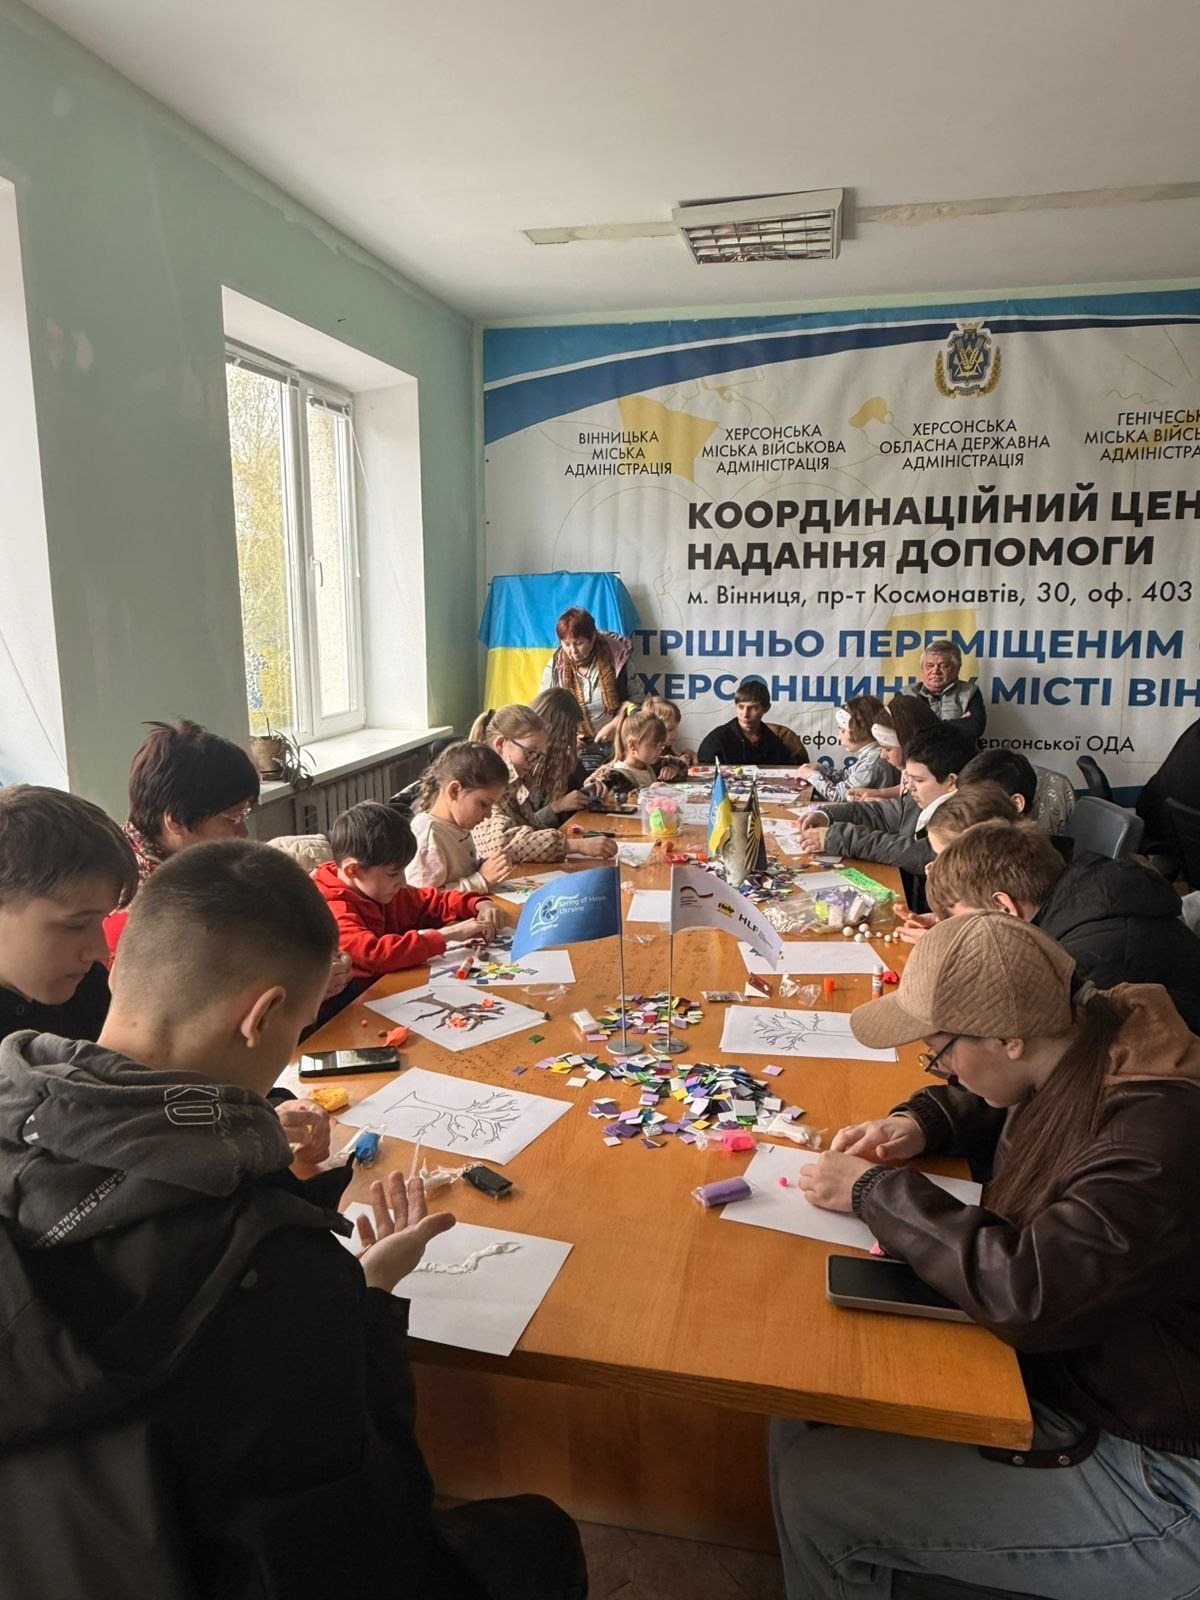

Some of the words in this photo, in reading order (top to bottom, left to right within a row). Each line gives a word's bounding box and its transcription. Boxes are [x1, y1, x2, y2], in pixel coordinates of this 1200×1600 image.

[725, 424, 822, 441] ХЕРСОНСЬКА
[913, 419, 1017, 436] ХЕРСОНСЬКА
[579, 430, 659, 446] ВІННИЦЬКА
[879, 440, 957, 455] ОБЛАСНА
[962, 435, 1051, 452] ДЕРЖАВНА
[1084, 430, 1146, 446] МІСЬКА
[592, 447, 646, 460] МІСЬКА
[701, 444, 757, 458] МІСЬКА
[762, 439, 846, 456] ВІЙСЬКОВА
[564, 462, 672, 478] АДМІНІСТРАЦІЯ
[716, 457, 829, 476] АДМІНІСТРАЦІЯ
[902, 453, 1024, 471] АДМІНІСТРАЦІЯ
[689, 482, 1098, 534] КООРДИНАЦІЙНИЙ
[1111, 490, 1200, 527] ЦЕН
[688, 540, 886, 576] НАДАННЯ
[896, 536, 1154, 574] ДОПОМОГИ
[687, 591, 708, 605] м.
[717, 585, 806, 608] Вінниця,
[817, 590, 866, 610] пр-т
[874, 583, 1026, 608] Космонавтів,
[1037, 582, 1076, 606] 30,
[1088, 582, 1131, 608] оф.
[1142, 581, 1192, 602] 403
[630, 630, 825, 657] ТРІШНЬО
[992, 677, 1111, 706] МІСТІ
[977, 735, 1081, 750] ерсонської
[1086, 736, 1135, 755] ОДА
[559, 899, 580, 908] Spring
[559, 906, 585, 914] Ukraine
[718, 902, 735, 914] Help
[738, 913, 759, 933] HLF
[50, 1201, 98, 1244] IBILITIES
[58, 1207, 79, 1227] THAT
